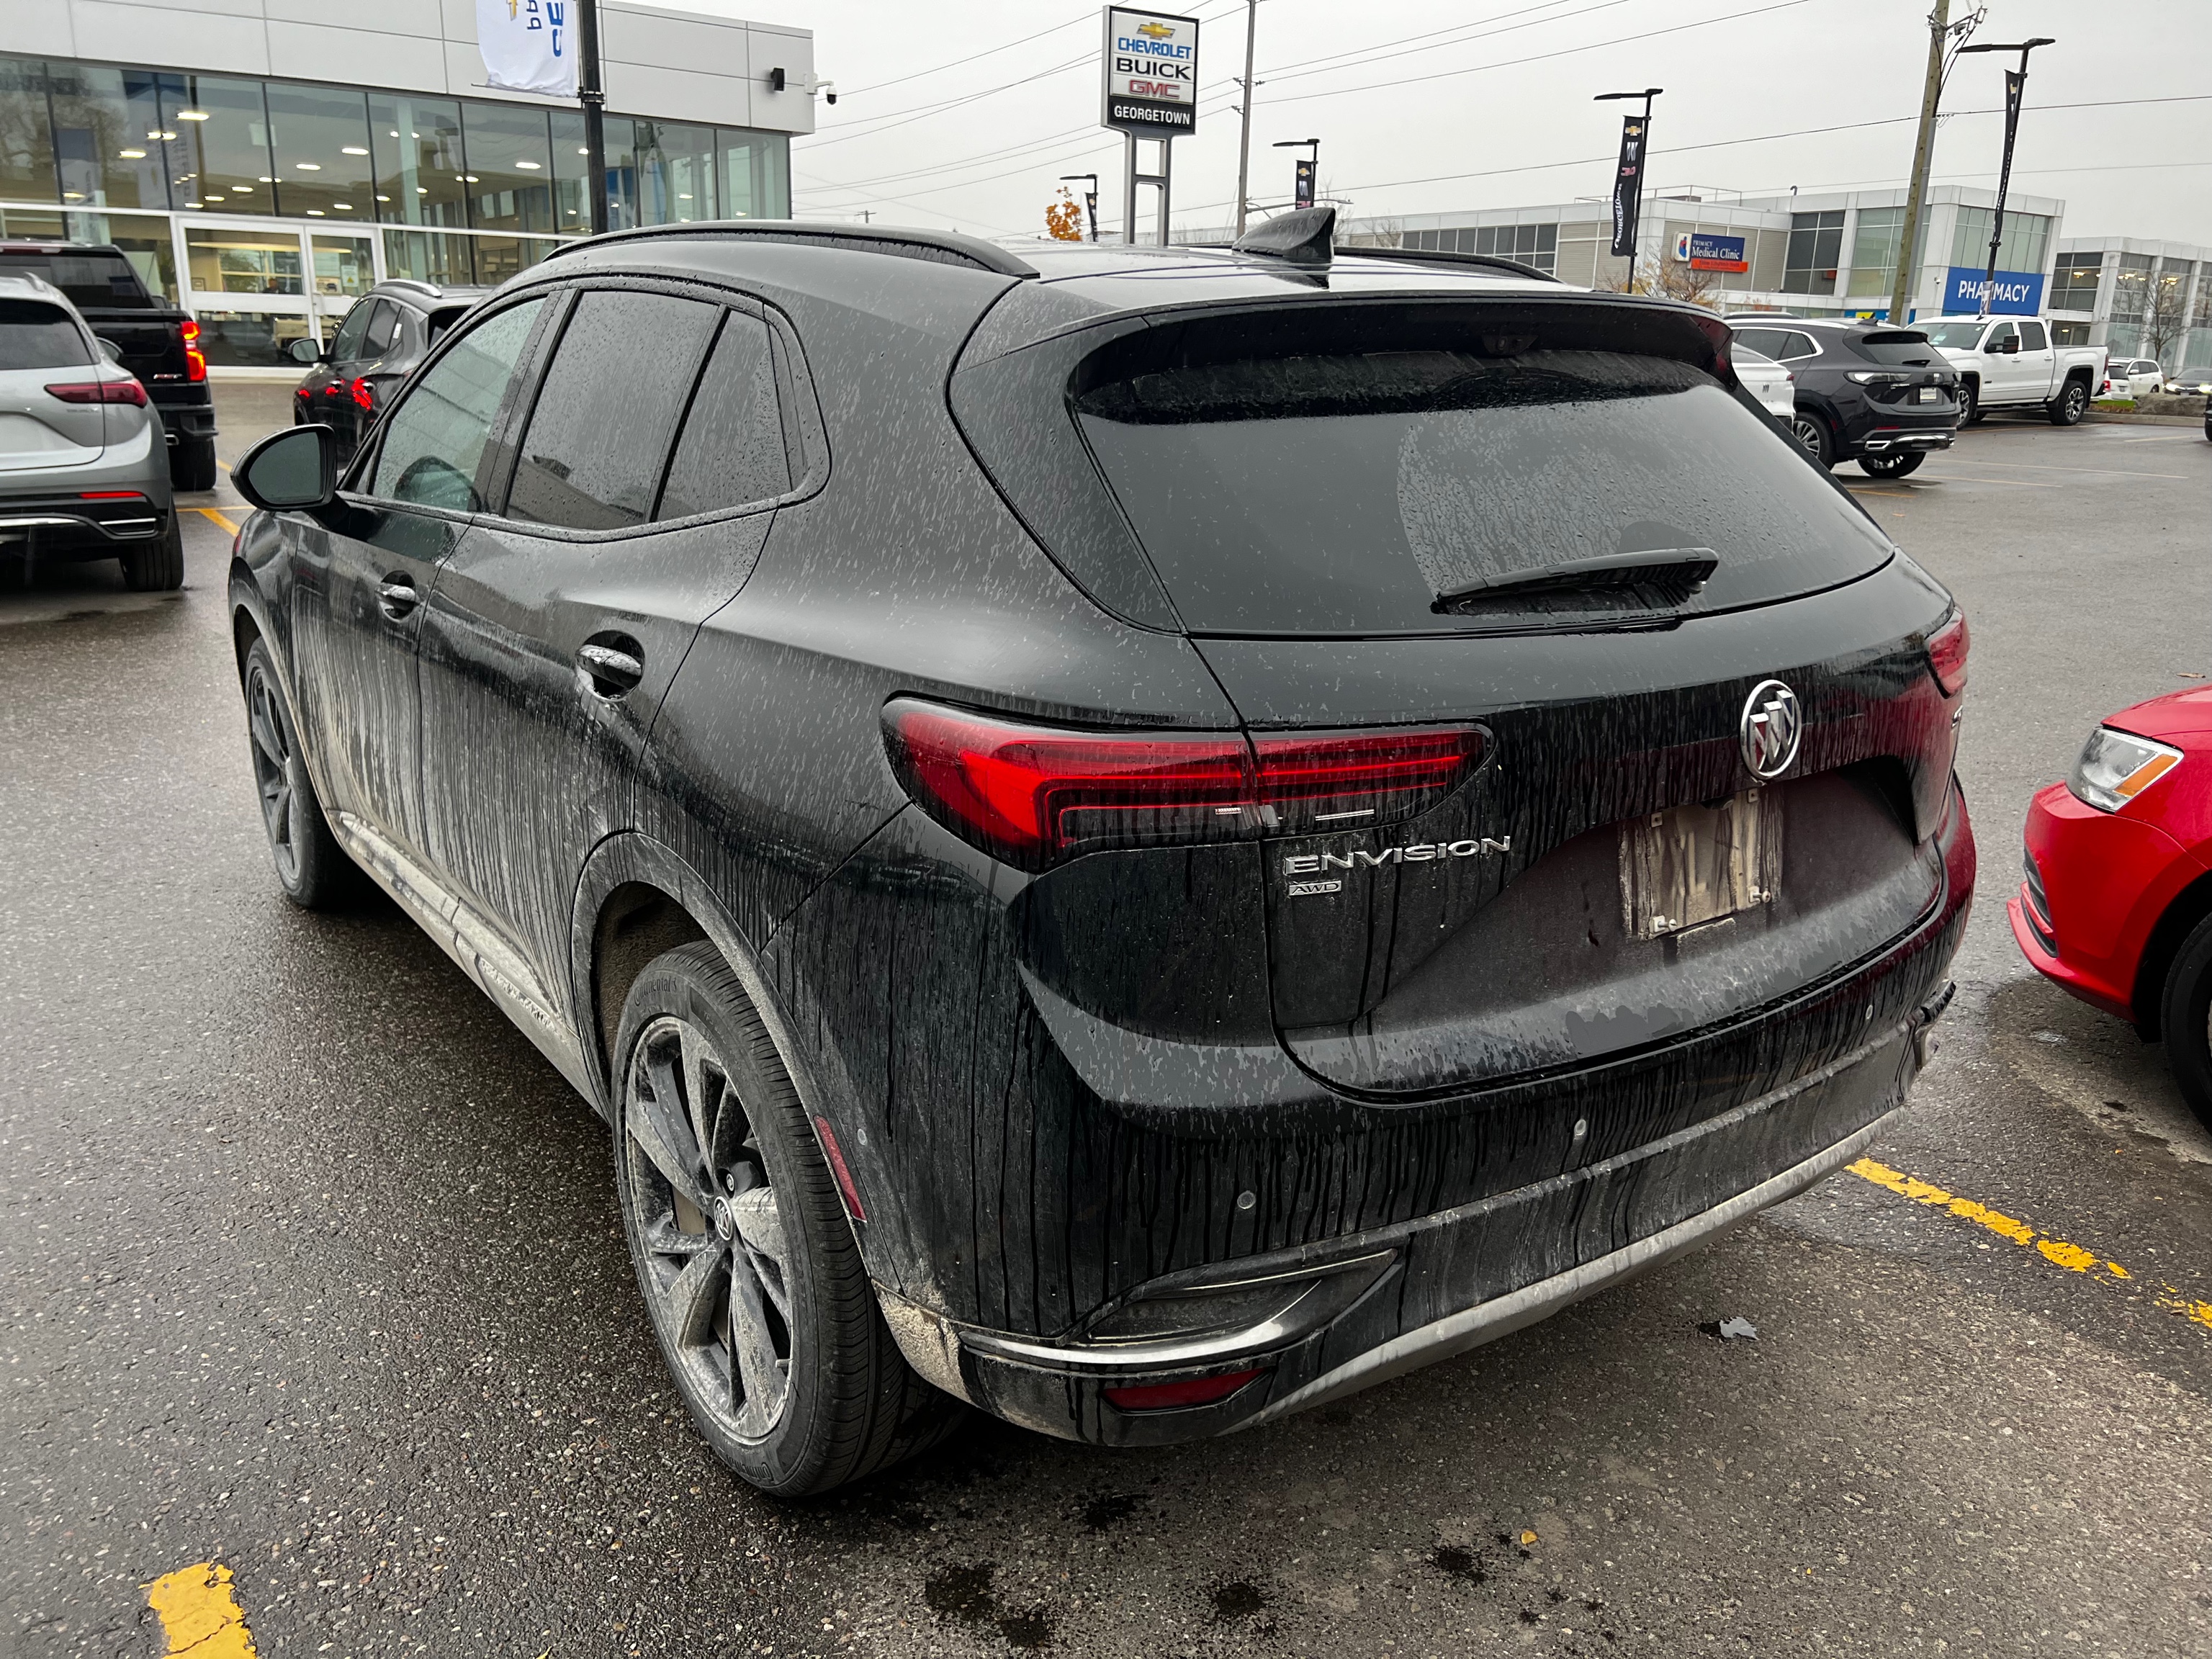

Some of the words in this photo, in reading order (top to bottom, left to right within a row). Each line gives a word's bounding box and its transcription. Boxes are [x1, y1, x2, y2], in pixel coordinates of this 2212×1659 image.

[1118, 37, 1192, 59] CHEVROLET
[1117, 58, 1192, 81] BUICK
[1129, 79, 1180, 99] GMC
[1114, 105, 1190, 125] GEORGETOWN
[1691, 246, 1719, 258] Medical
[1719, 248, 1740, 260] Clinic
[1958, 280, 2030, 302] PHAMACY
[1284, 835, 1511, 875] ENVISION
[1291, 882, 1340, 894] AWD
